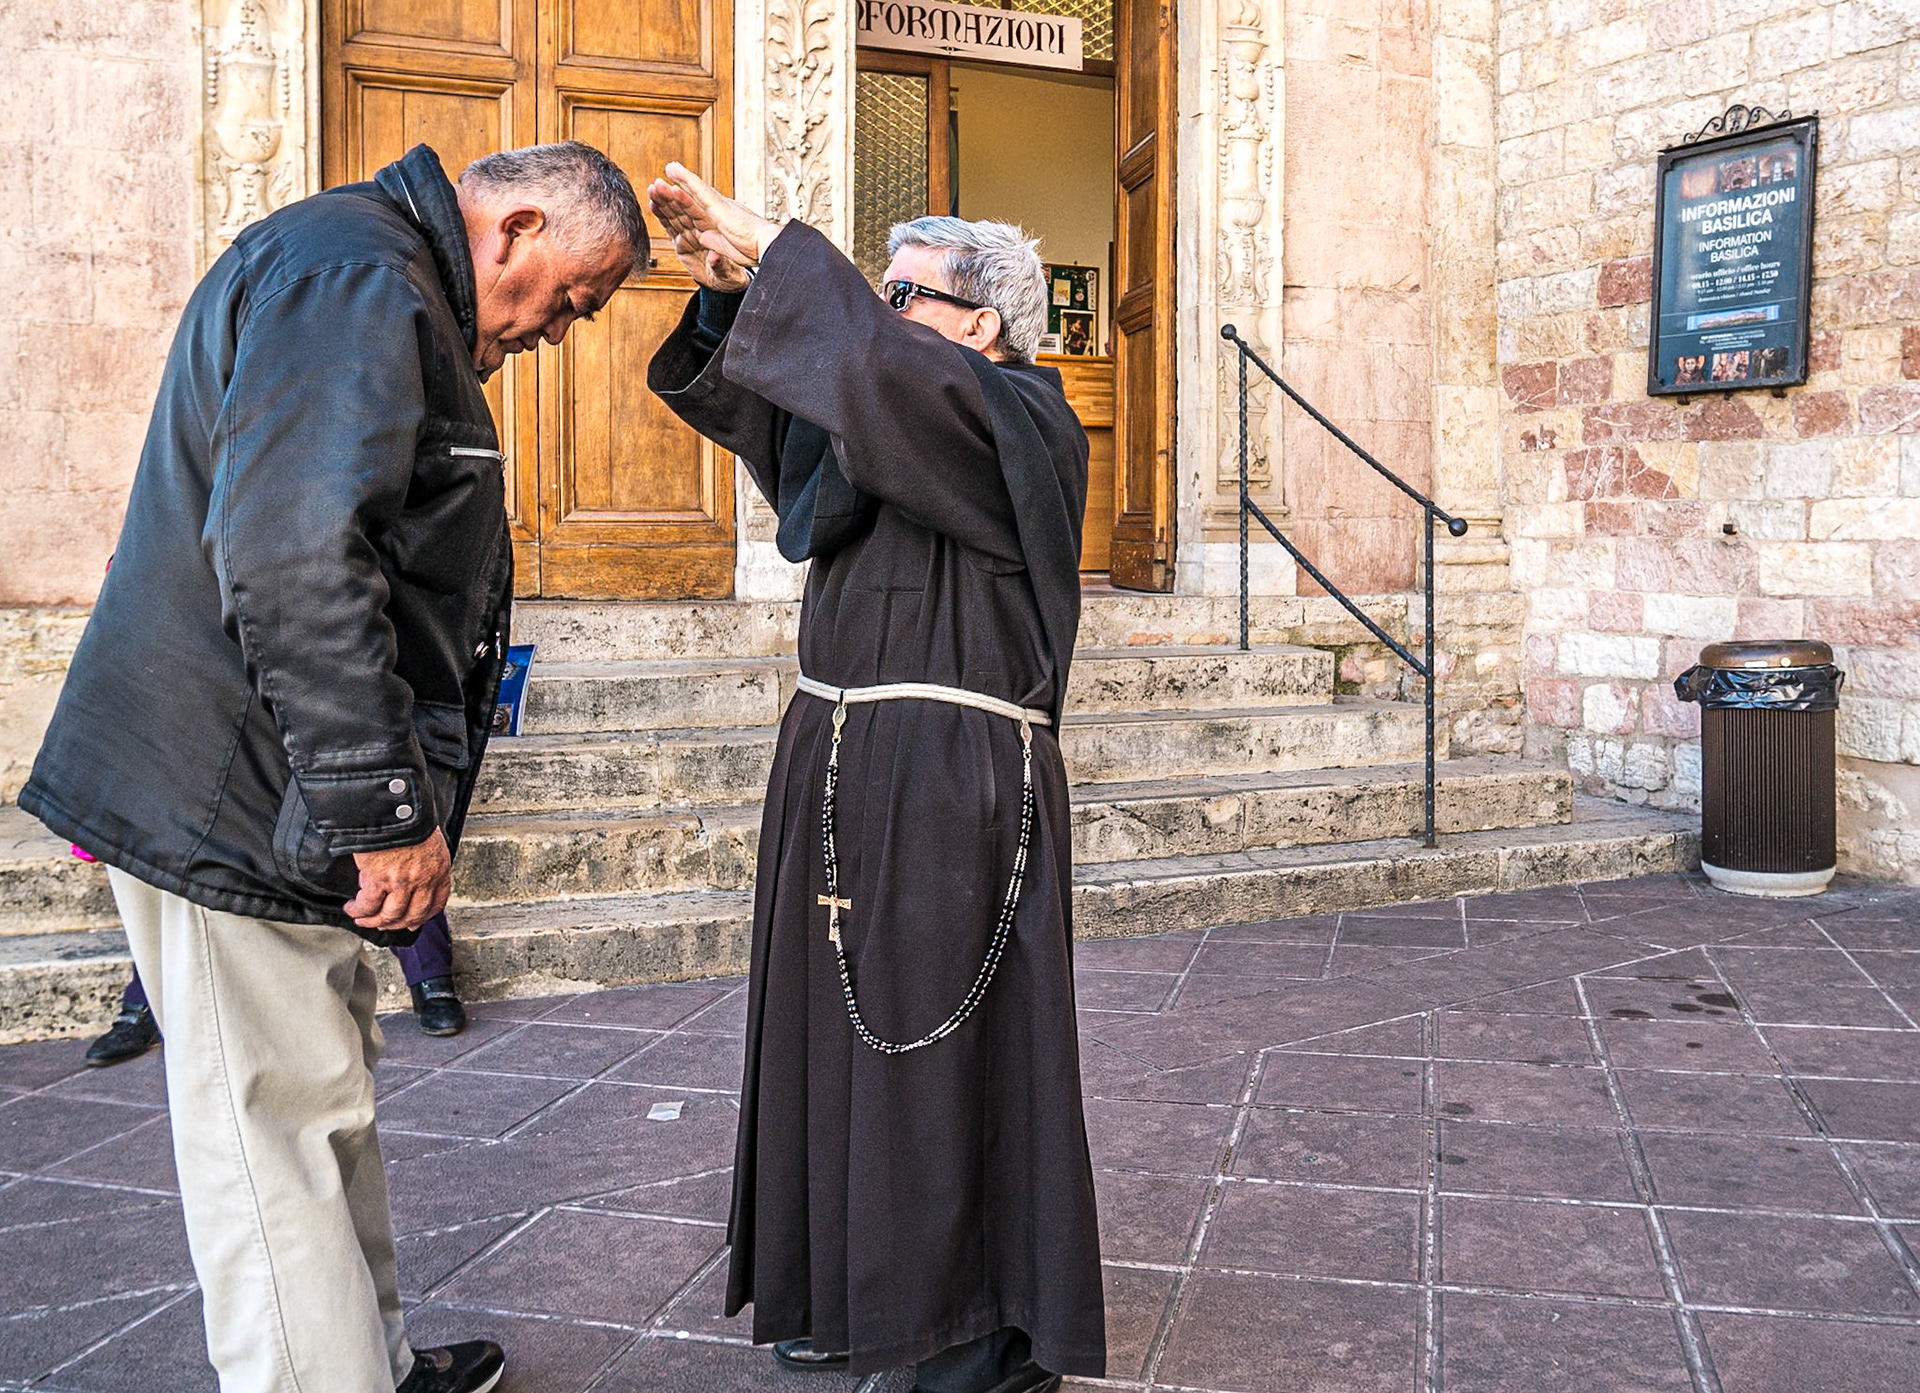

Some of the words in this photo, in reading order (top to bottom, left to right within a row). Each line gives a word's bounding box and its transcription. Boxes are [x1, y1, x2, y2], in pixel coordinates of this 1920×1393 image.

[1682, 187, 1795, 222] INFORMAZIONI
[1702, 209, 1773, 235] BASILICA
[1699, 230, 1772, 252] INFORMATION
[1710, 245, 1759, 263] BASILICA
[1760, 261, 1780, 270] hours
